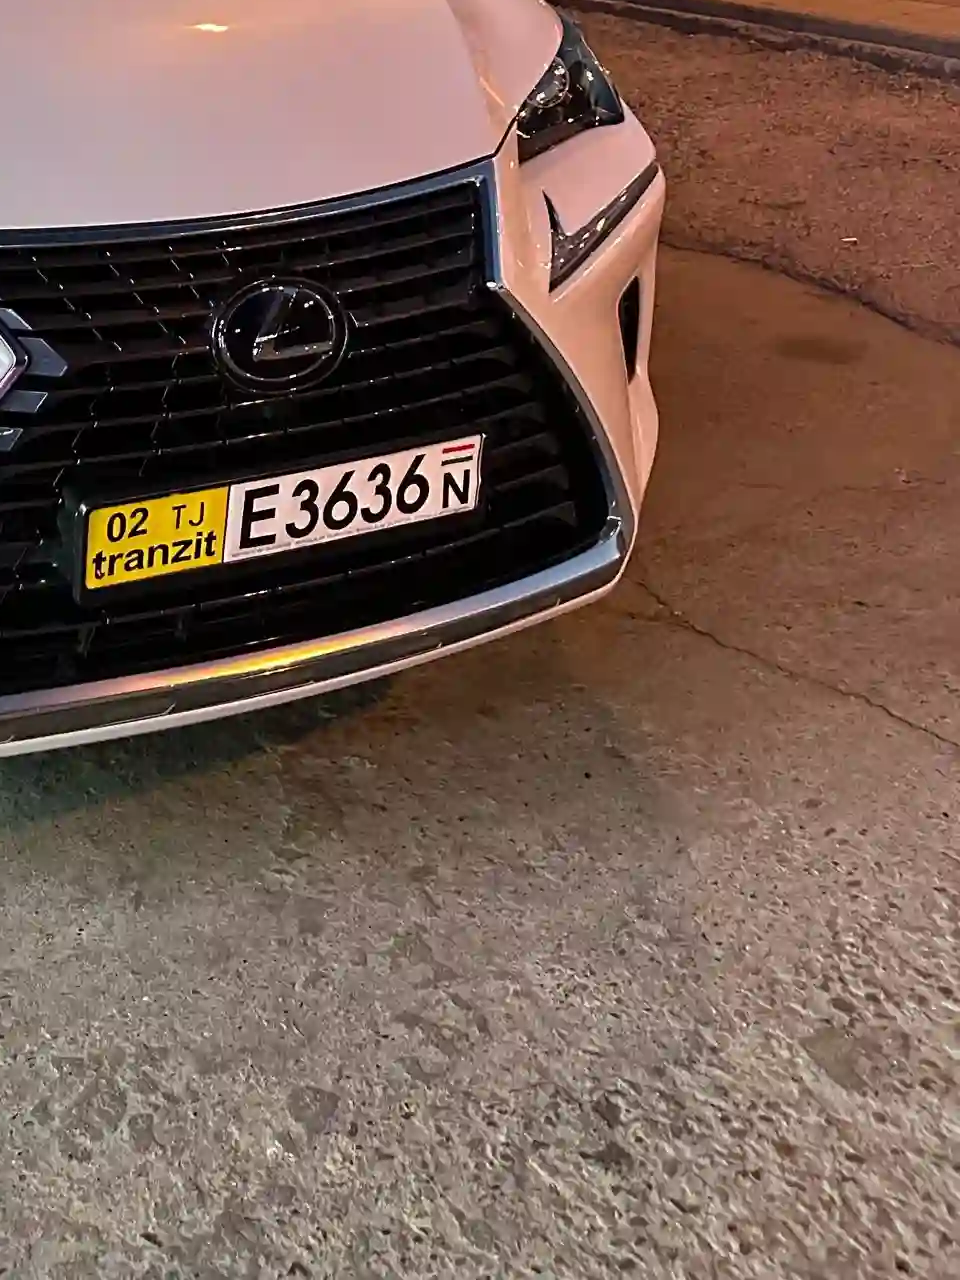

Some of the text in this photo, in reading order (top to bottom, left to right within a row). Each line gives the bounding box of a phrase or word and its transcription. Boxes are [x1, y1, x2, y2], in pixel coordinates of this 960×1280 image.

[107, 502, 205, 543] 02 TJ
[239, 453, 430, 549] E3636
[442, 468, 471, 509] N
[92, 530, 217, 580] tranzit
